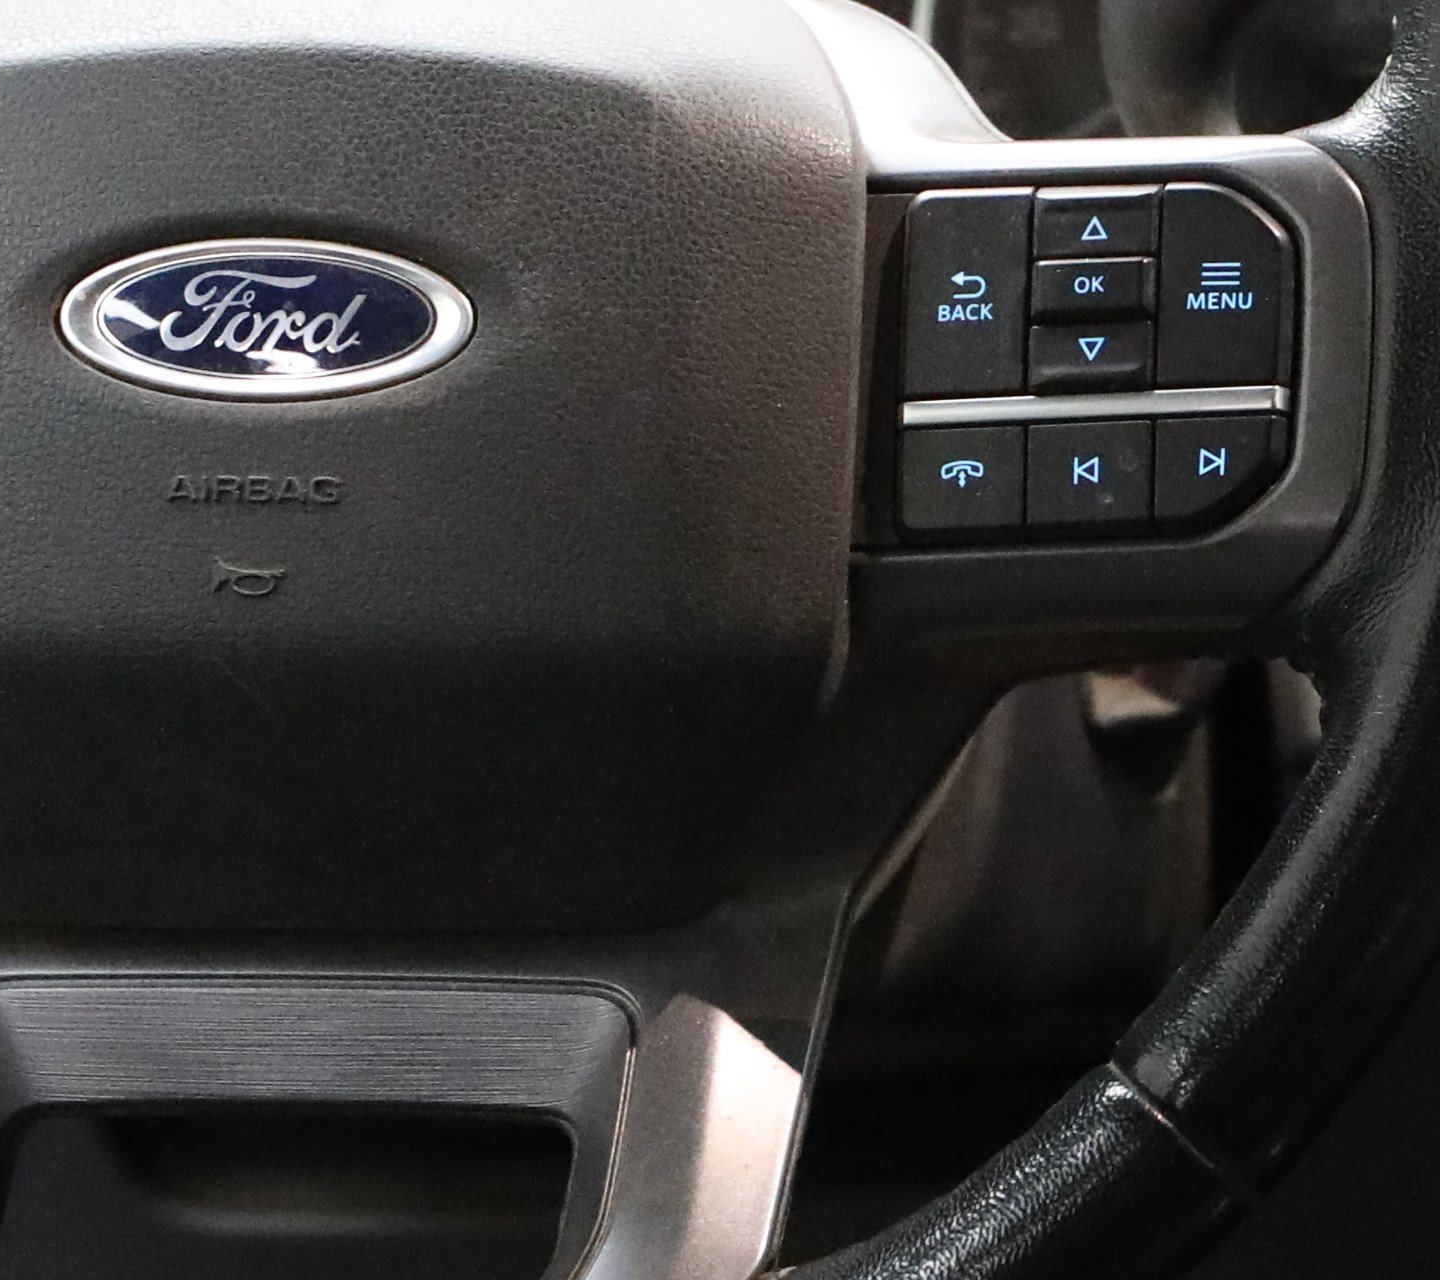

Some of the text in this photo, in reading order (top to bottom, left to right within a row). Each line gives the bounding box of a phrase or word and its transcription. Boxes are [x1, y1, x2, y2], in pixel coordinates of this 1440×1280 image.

[1073, 275, 1105, 294] OK
[1186, 291, 1253, 310] MENU
[159, 269, 367, 354] Ford
[937, 302, 994, 323] BACK
[167, 472, 346, 505] AIRBAG
